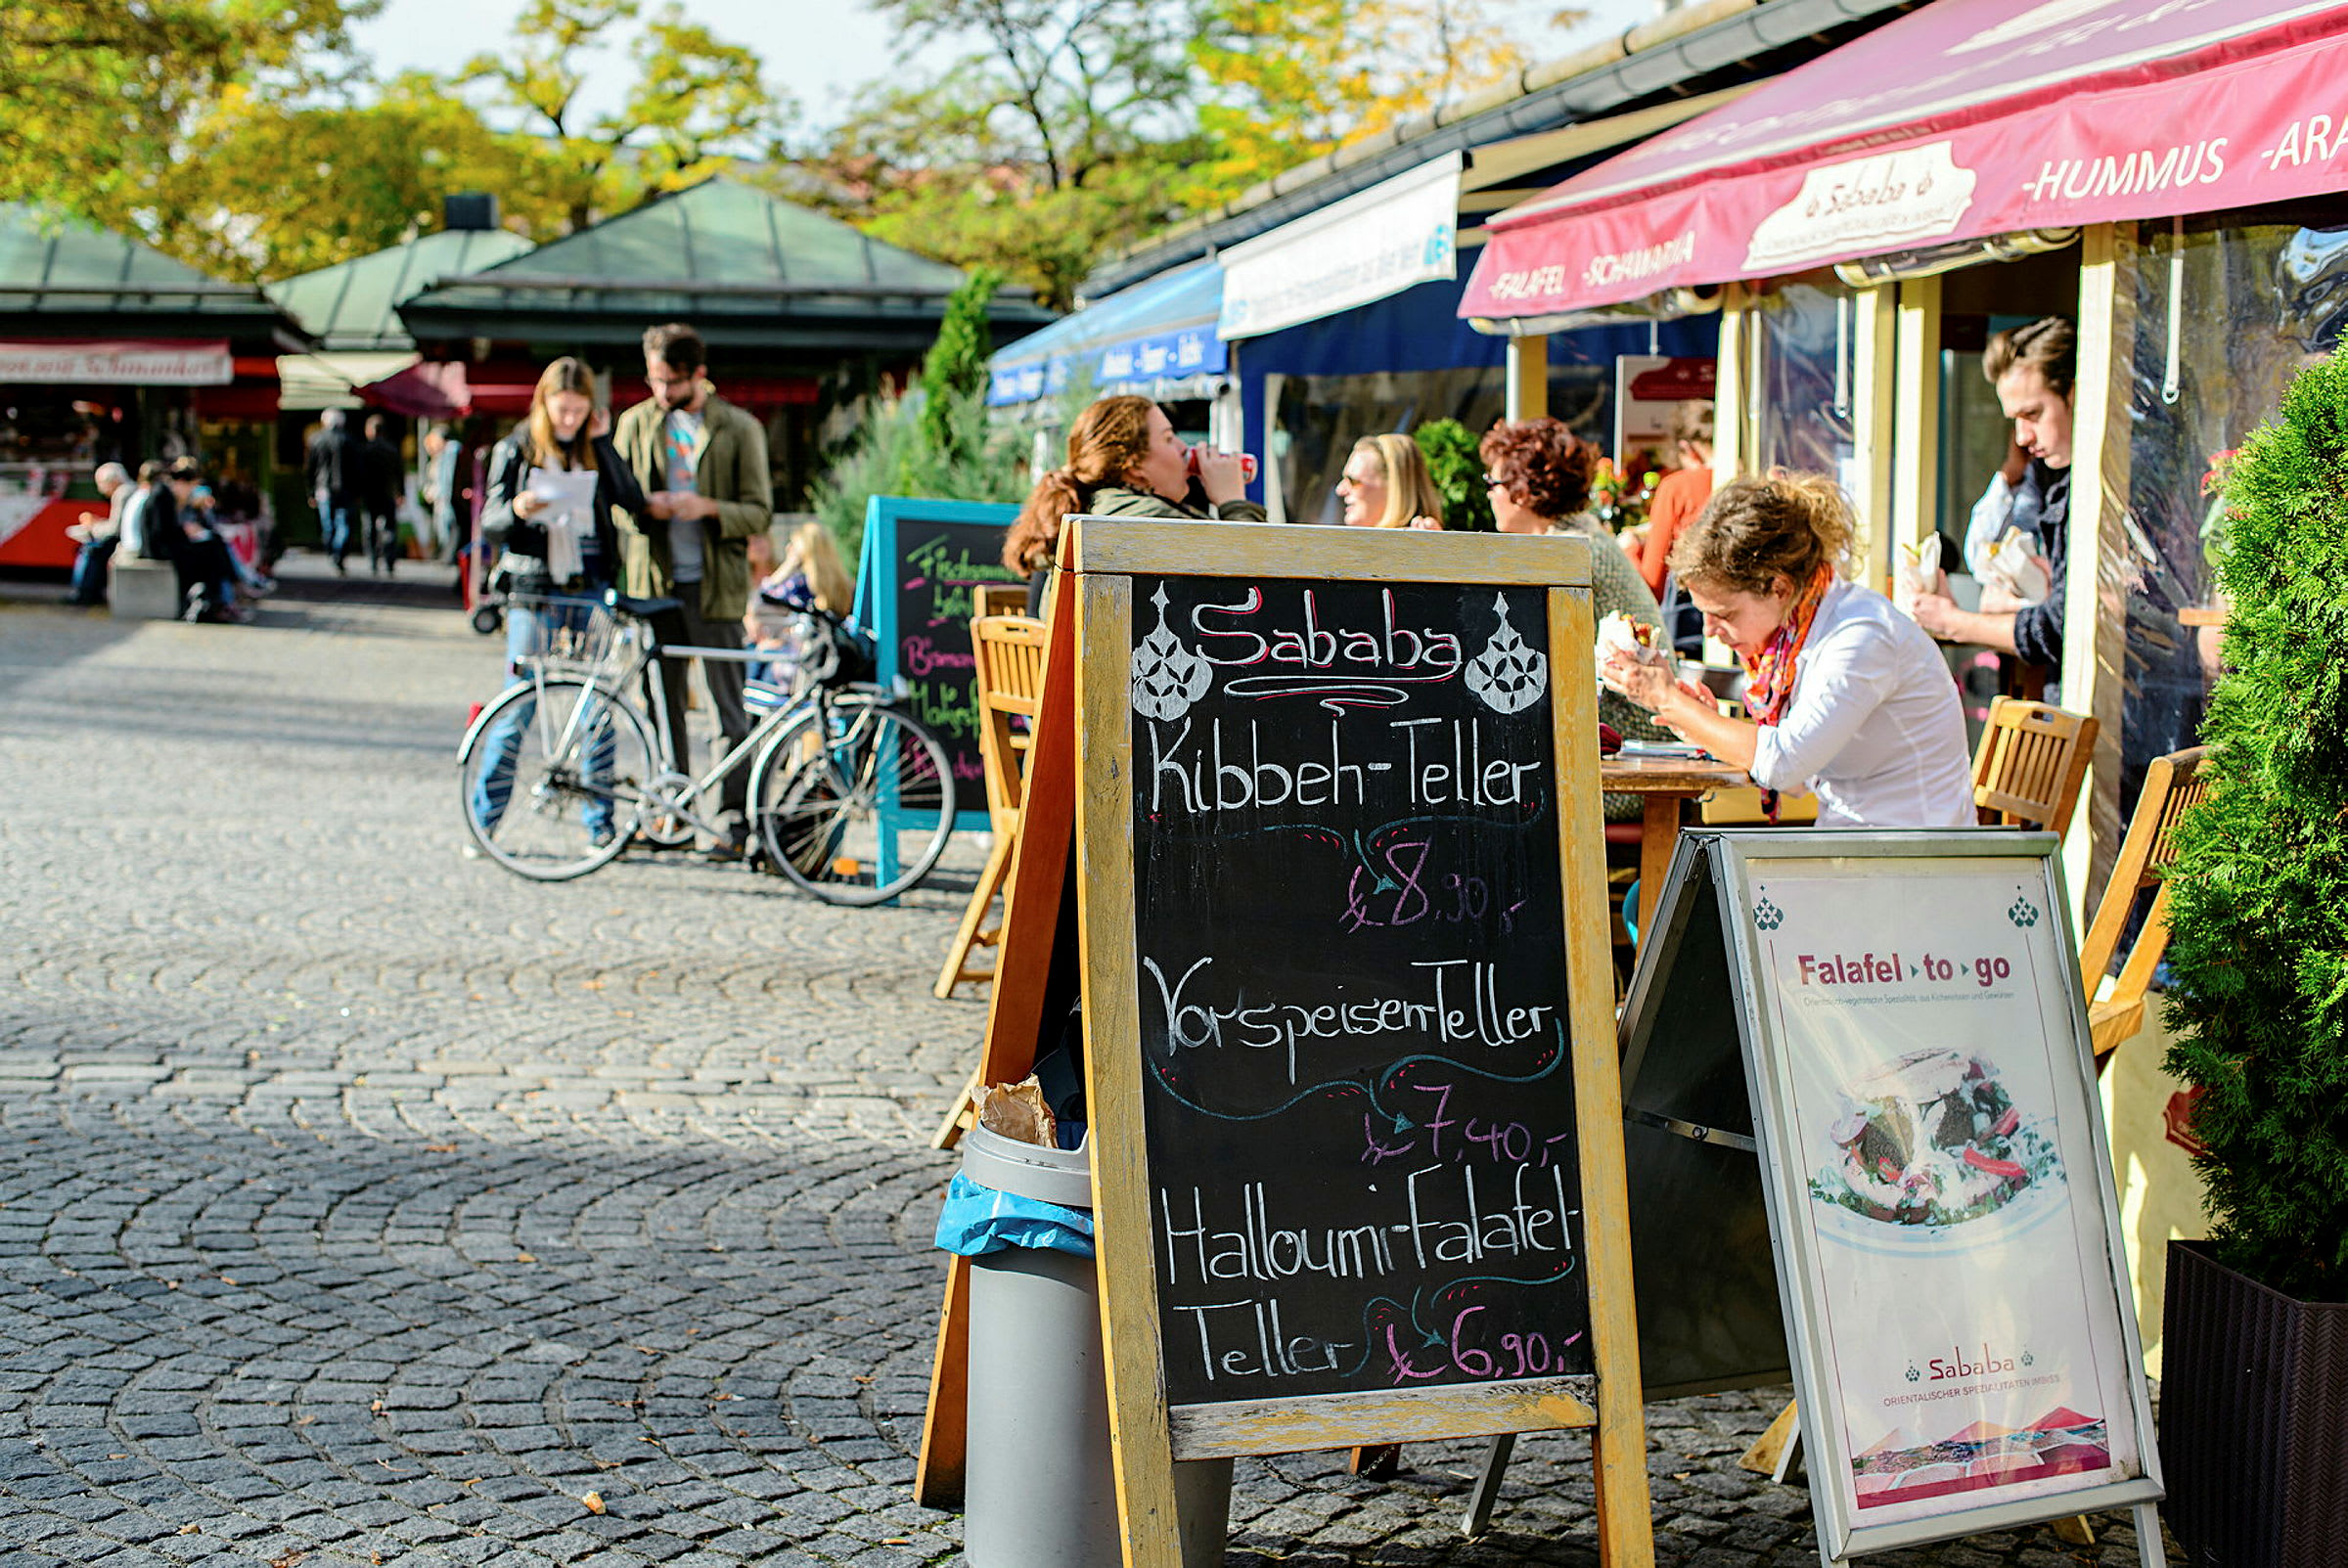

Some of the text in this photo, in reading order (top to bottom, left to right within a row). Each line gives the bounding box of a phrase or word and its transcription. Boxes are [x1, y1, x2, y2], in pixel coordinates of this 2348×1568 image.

[2022, 137, 2229, 202] -HUMMUS
[1191, 586, 1463, 670] Sababa
[1798, 952, 2010, 988] Falafel to go
[1173, 1298, 1354, 1382] Teller
[1928, 1342, 2015, 1381] Sababa
[1883, 1387, 1961, 1407] ORIENTALISCHER
